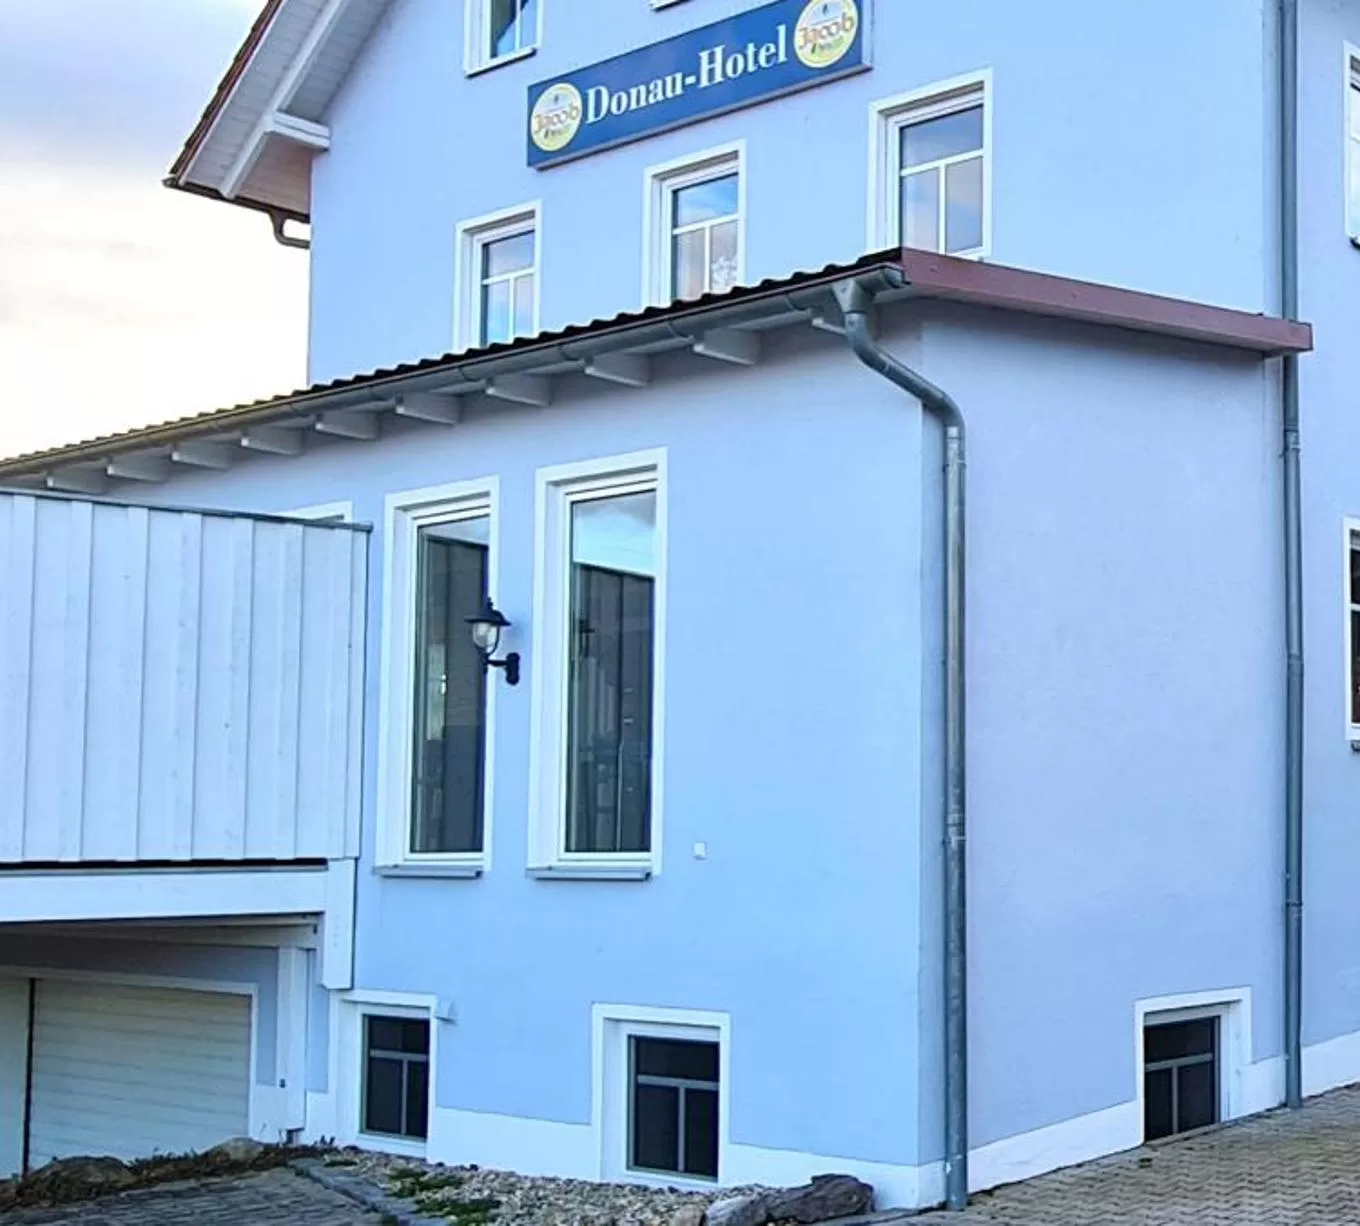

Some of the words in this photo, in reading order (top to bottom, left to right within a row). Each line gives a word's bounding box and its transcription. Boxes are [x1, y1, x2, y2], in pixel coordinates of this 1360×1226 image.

[799, 11, 854, 49] Jacob
[585, 25, 788, 124] Donau-Hotel
[534, 102, 580, 133] Jacob
